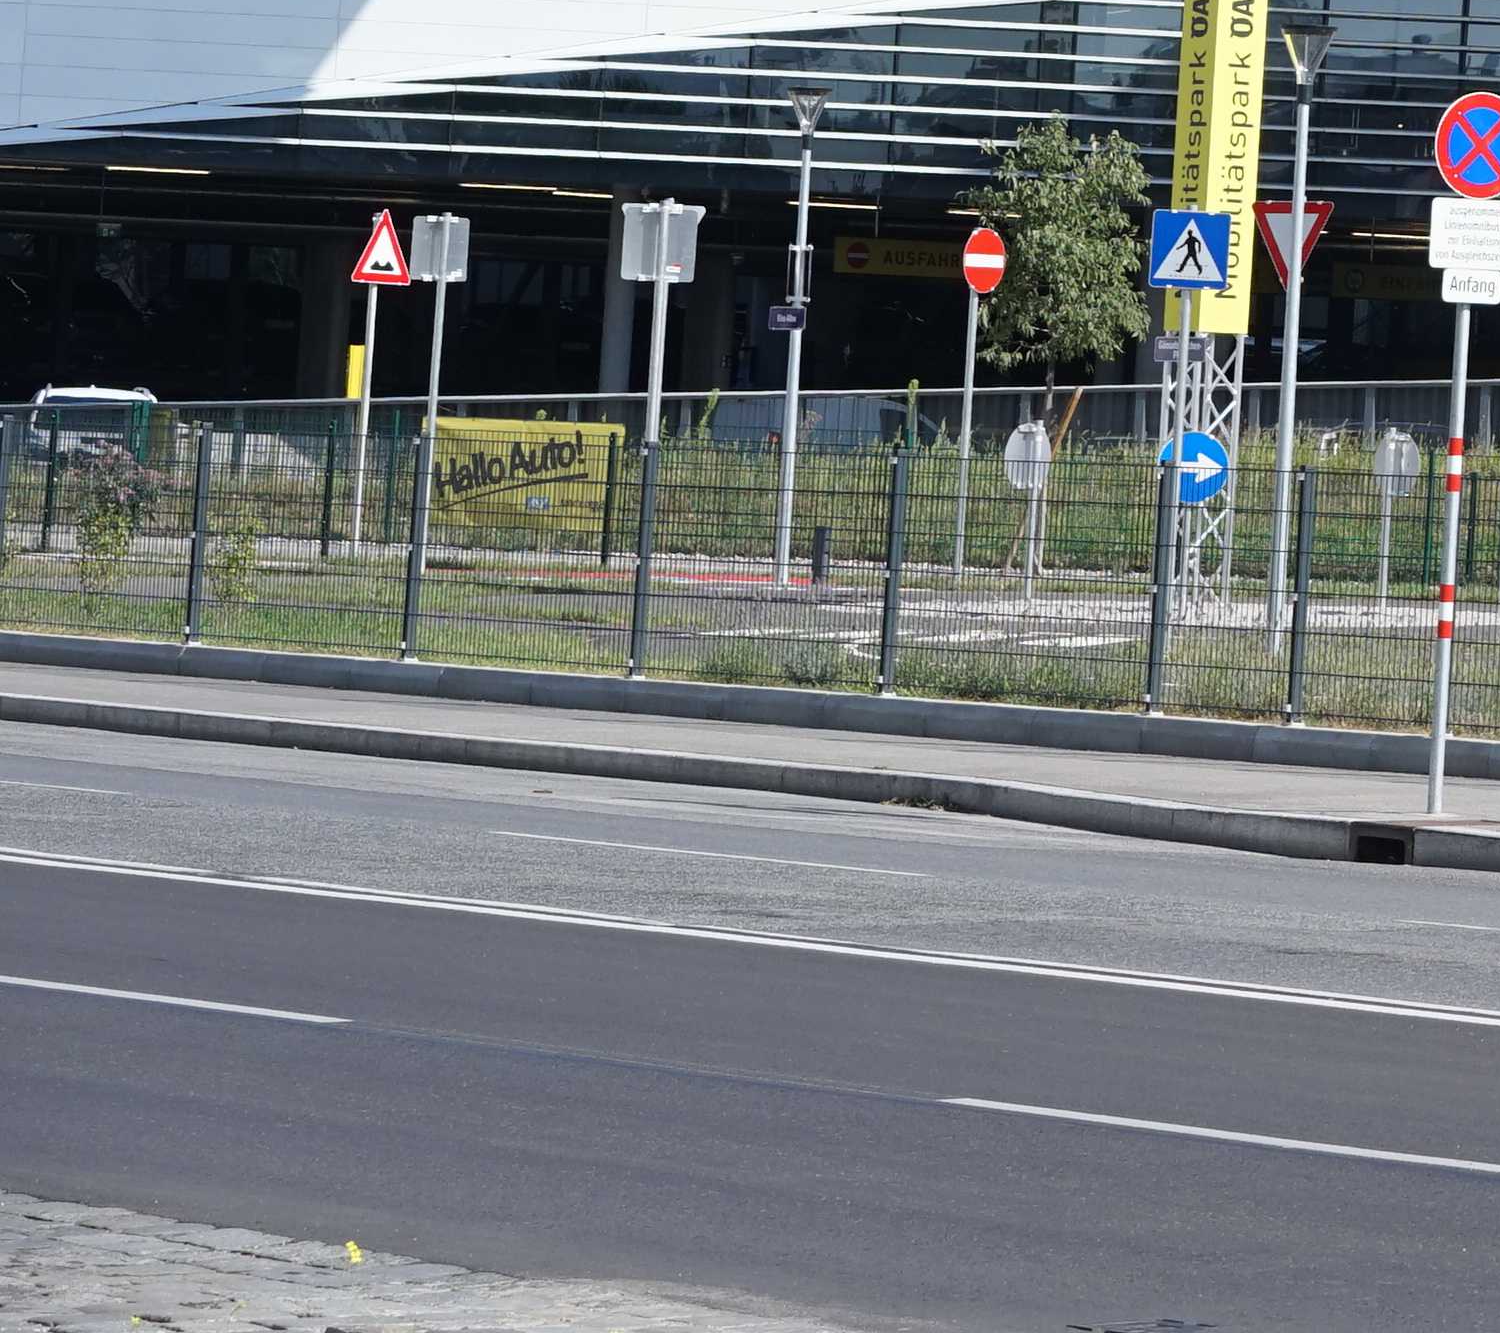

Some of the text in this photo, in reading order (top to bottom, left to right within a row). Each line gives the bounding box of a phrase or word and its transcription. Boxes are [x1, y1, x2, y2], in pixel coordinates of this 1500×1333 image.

[883, 249, 961, 268] AUSFAHR
[1449, 276, 1496, 297] Anfang
[434, 430, 586, 498] Hallo Auto!
